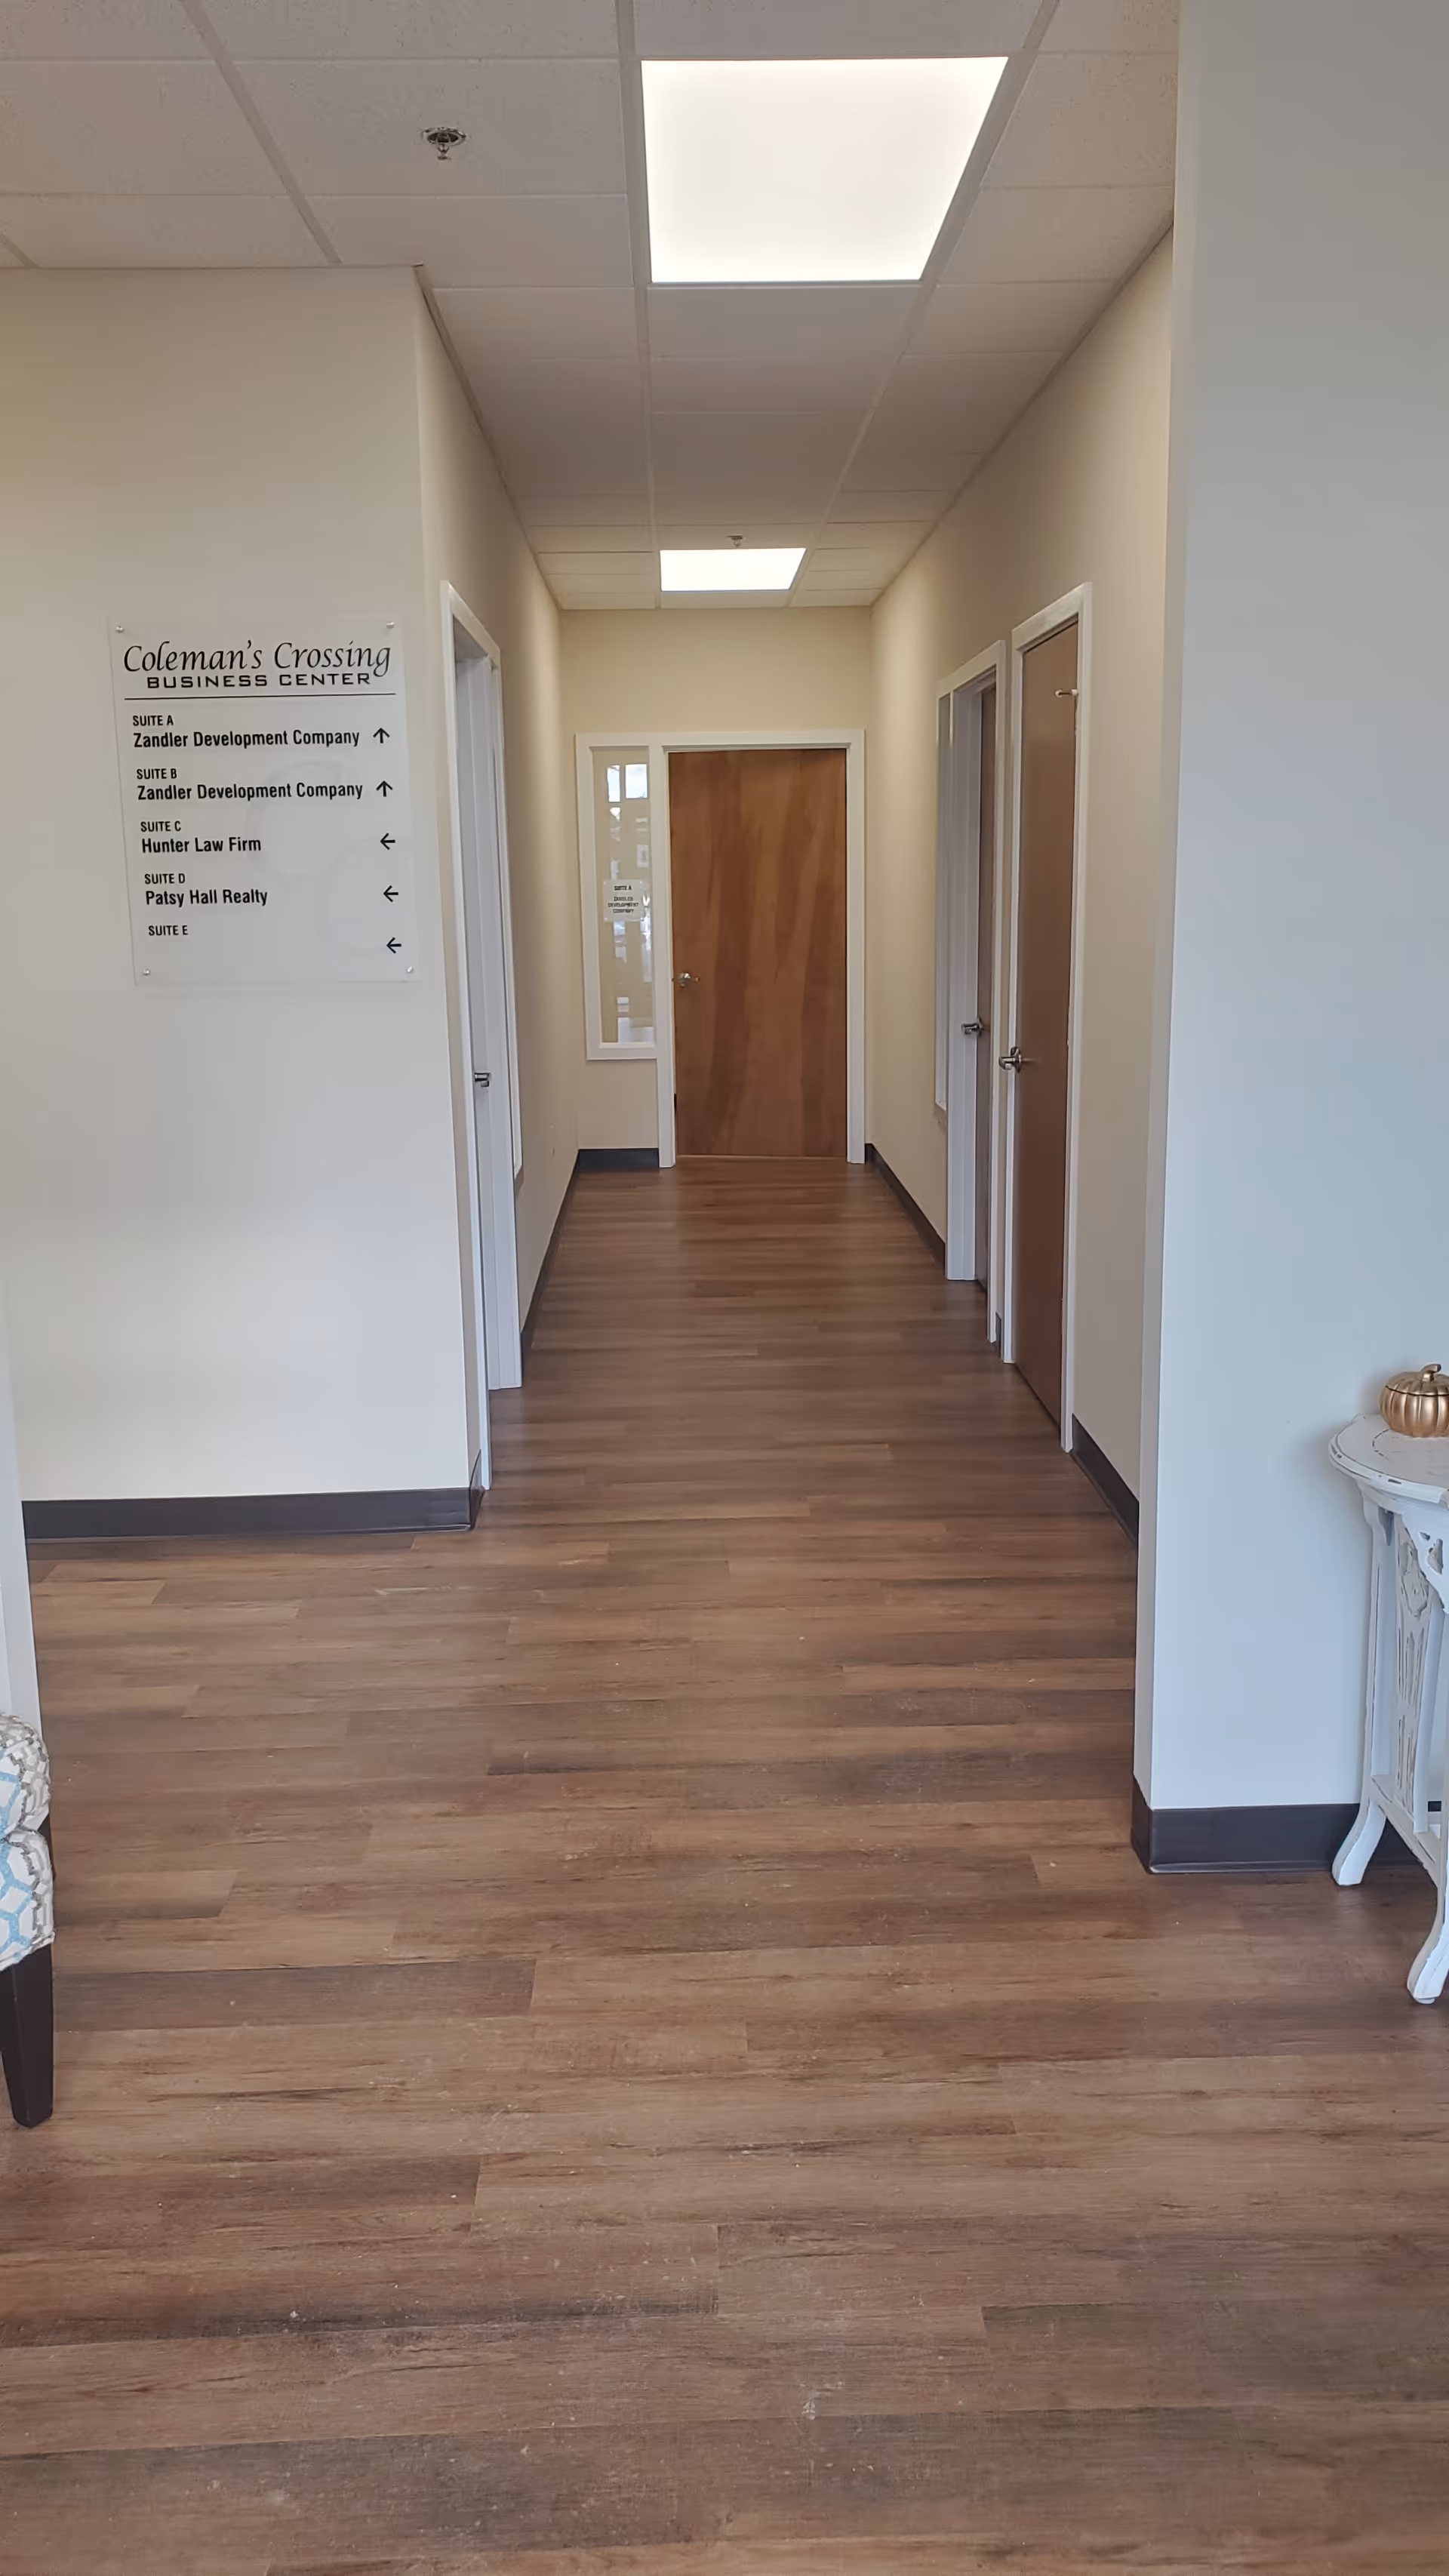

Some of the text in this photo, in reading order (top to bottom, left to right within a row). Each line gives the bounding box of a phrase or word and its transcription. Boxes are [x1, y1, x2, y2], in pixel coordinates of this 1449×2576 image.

[125, 639, 390, 677] Coleman's Crossing
[147, 673, 370, 688] BUSINESS CENTER
[133, 715, 174, 726] SUITE A
[134, 730, 359, 749] Zandler Development Company
[137, 768, 177, 780] SUITE B
[137, 783, 362, 802] Zandler Development Company
[140, 820, 181, 833] SUITE C
[142, 837, 261, 853] Hunter Law Firm
[145, 873, 185, 885] SUITE D
[146, 889, 267, 908] Patsy Hall Realty
[149, 925, 188, 936] SUITE E
